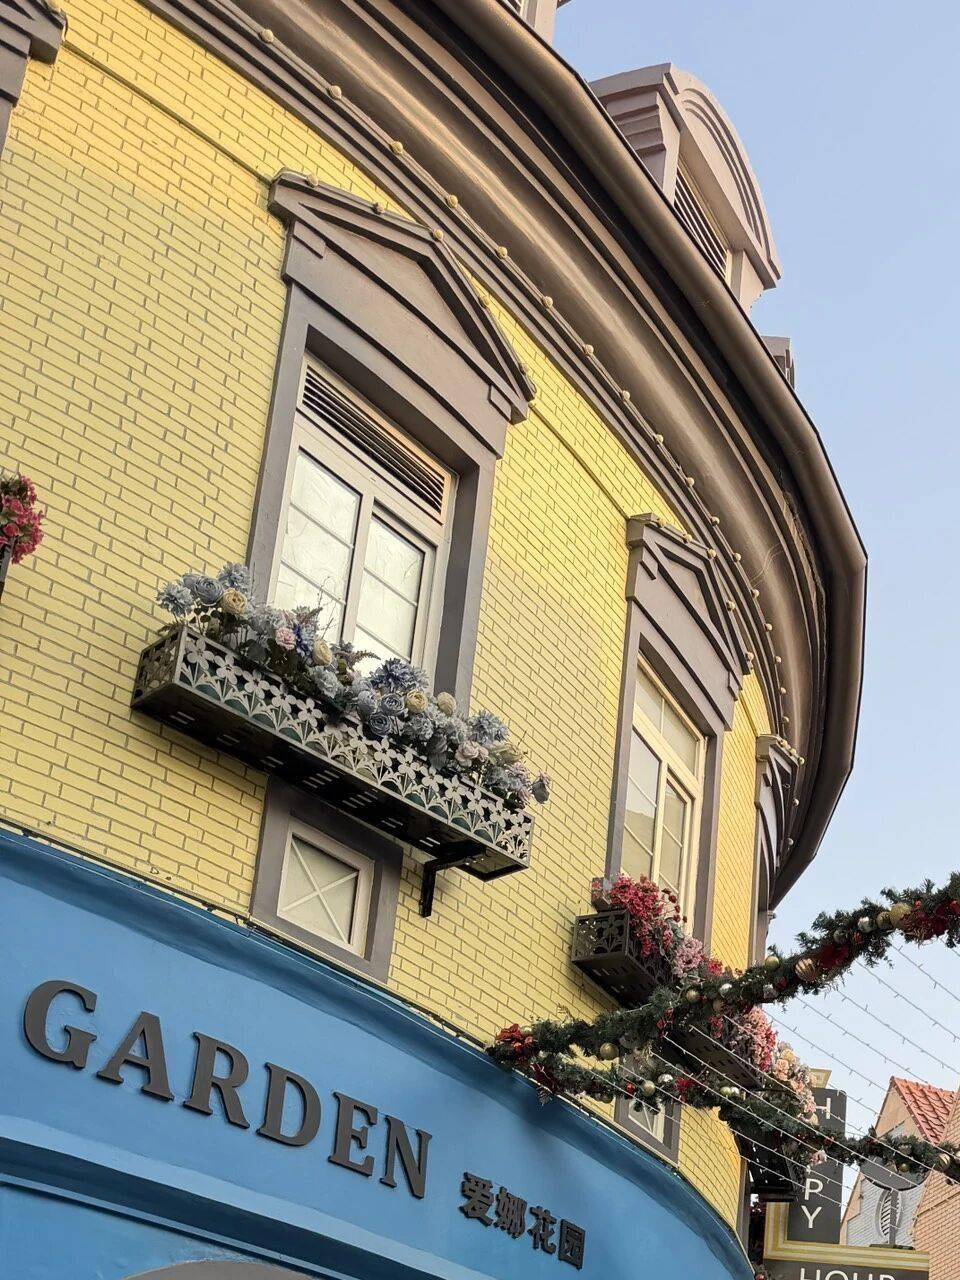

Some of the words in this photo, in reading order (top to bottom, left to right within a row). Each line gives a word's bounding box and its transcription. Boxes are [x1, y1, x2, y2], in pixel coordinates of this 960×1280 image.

[23, 980, 433, 1200] GARDEN
[458, 1171, 586, 1271] 爱娜花园
[801, 1097, 832, 1230] HPY
